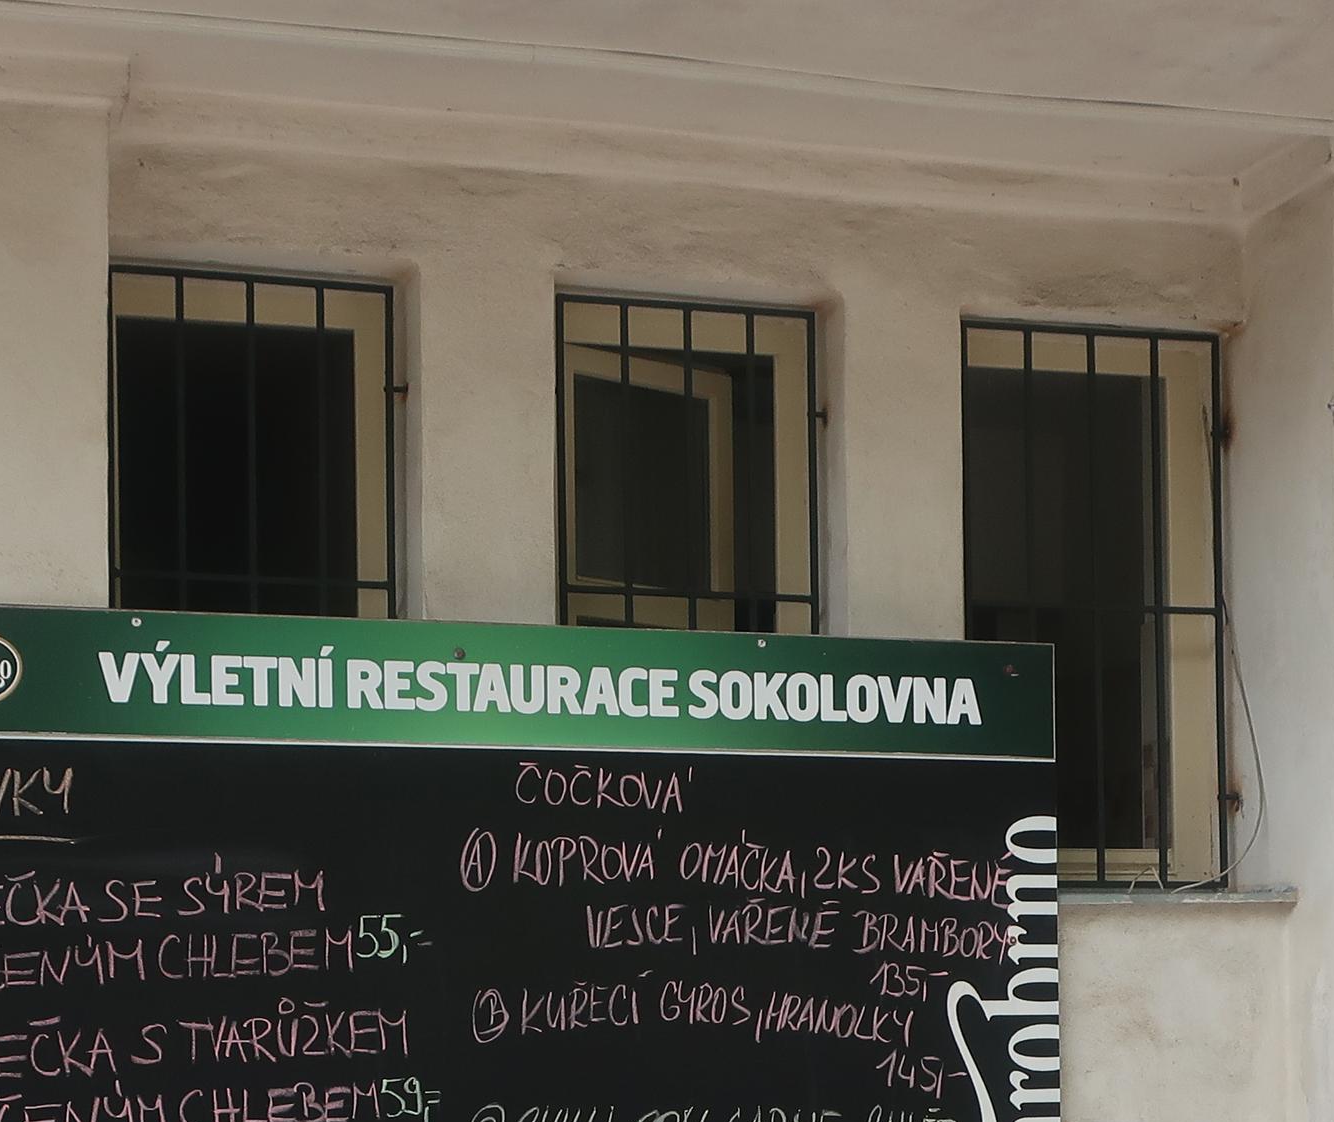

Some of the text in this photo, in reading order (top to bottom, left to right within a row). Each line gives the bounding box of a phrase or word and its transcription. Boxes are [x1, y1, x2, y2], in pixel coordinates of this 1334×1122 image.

[98, 640, 983, 726] VÝLETNÍ RESTAURACE SOKOLOVNA
[513, 828, 663, 887] KOPROVÁ
[97, 880, 162, 922] SE
[158, 926, 354, 980] CHLEBEM
[852, 910, 1010, 966] BRAMBORY
[130, 1023, 168, 1066] S
